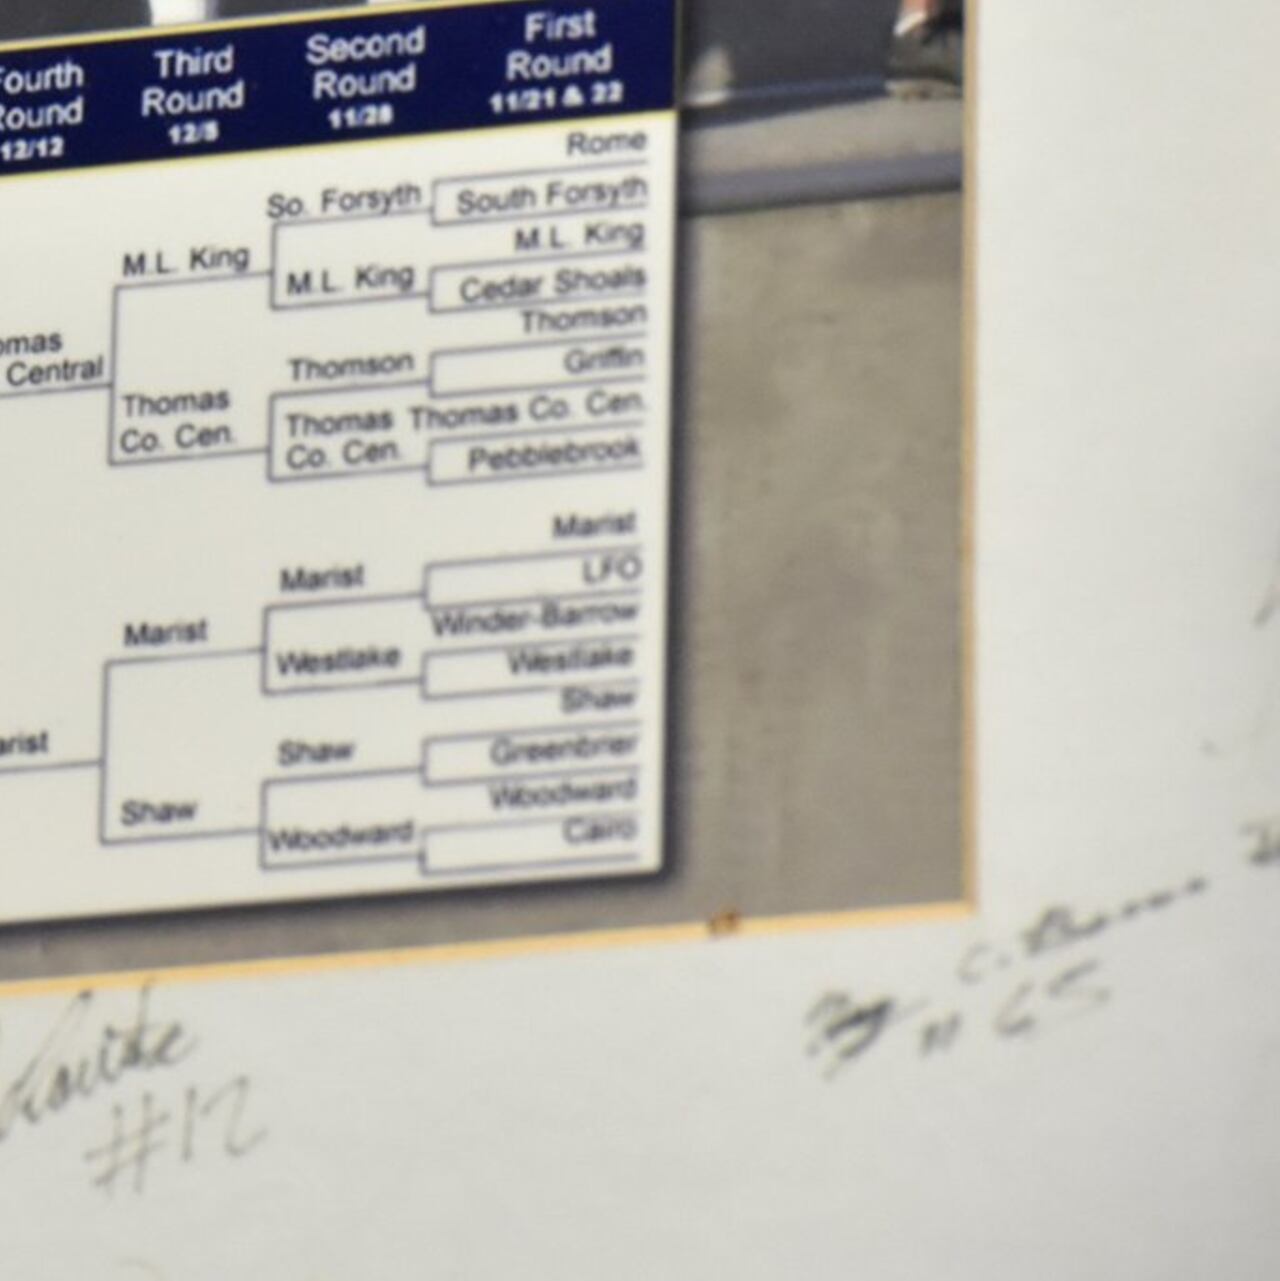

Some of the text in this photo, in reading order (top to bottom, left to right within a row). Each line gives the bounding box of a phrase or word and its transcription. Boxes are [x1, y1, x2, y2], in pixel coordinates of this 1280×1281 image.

[525, 10, 596, 42] First
[306, 26, 425, 65] Second
[154, 45, 235, 80] Third
[506, 45, 612, 81] Round
[314, 65, 416, 99] Round
[141, 80, 243, 116] Round
[568, 129, 648, 156] Rome
[267, 183, 422, 219] So. Forsyth
[457, 176, 648, 216] South Forsyth
[585, 220, 646, 252] King
[190, 244, 249, 275] King
[355, 264, 414, 294] King
[460, 263, 647, 304] Cedar Shoals
[521, 303, 648, 334] Thomson
[6, 355, 104, 388] Central
[288, 352, 414, 382] Thomson
[564, 348, 645, 375] Griffin
[123, 388, 230, 418] Thomas
[411, 401, 518, 432] Thomas
[286, 409, 394, 438] Thomas
[120, 430, 164, 455] Co.
[286, 444, 332, 471] Co.
[468, 437, 639, 473] Pebblebrook
[552, 511, 636, 540] Marist
[280, 563, 365, 592] Marist
[583, 555, 642, 585] LFO
[124, 618, 208, 648] Marist
[277, 644, 400, 677] Westlake
[508, 644, 634, 677] Westlake
[561, 686, 636, 714] Shaw
[278, 739, 355, 767] Shaw
[122, 799, 198, 825] Shaw
[268, 820, 414, 853] Woodward
